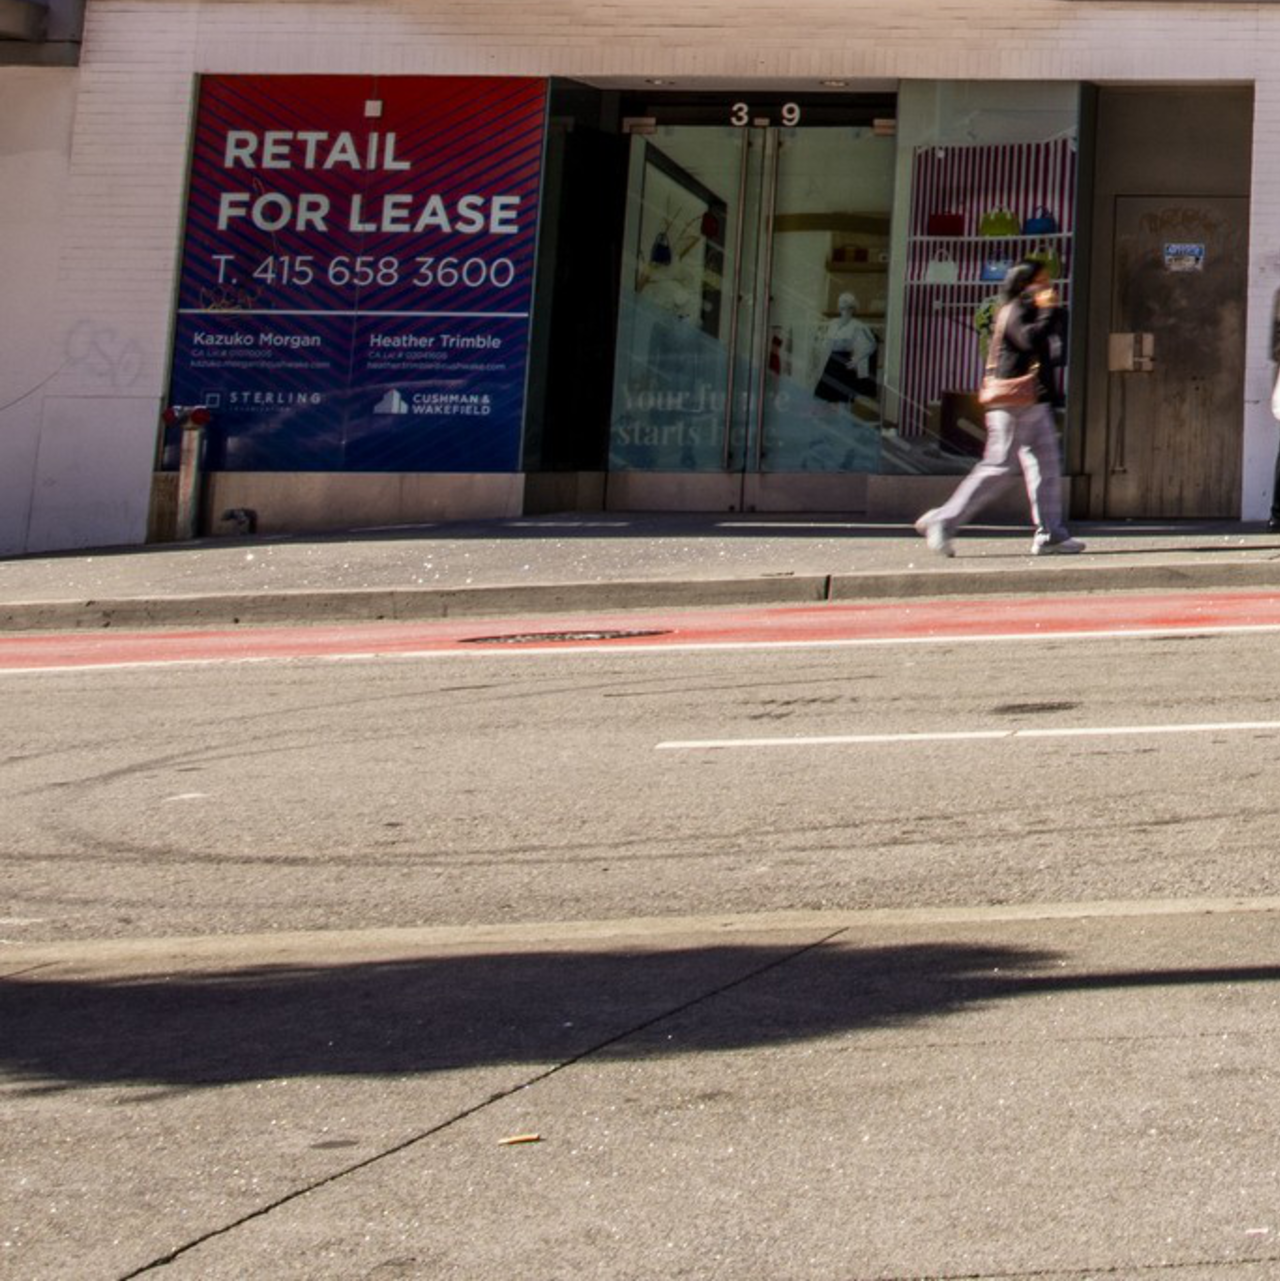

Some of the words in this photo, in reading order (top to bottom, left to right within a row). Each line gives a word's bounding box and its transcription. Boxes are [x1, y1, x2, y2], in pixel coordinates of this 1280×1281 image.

[223, 130, 411, 170] RETAIL
[217, 191, 331, 232] FOR
[349, 193, 522, 234] LEASE
[212, 255, 238, 284] T.
[252, 255, 315, 286] 415
[327, 255, 400, 287] 658
[412, 256, 516, 288] 3600
[193, 332, 254, 346] Kazuko
[259, 333, 322, 349] Morgan
[370, 334, 435, 348] Heather
[439, 334, 502, 349] Trimble
[229, 391, 322, 404] STERLING
[412, 394, 479, 404] CUSHMAN
[481, 395, 491, 404] &
[412, 405, 491, 415] WAKEFIELD
[616, 420, 700, 447] starts
